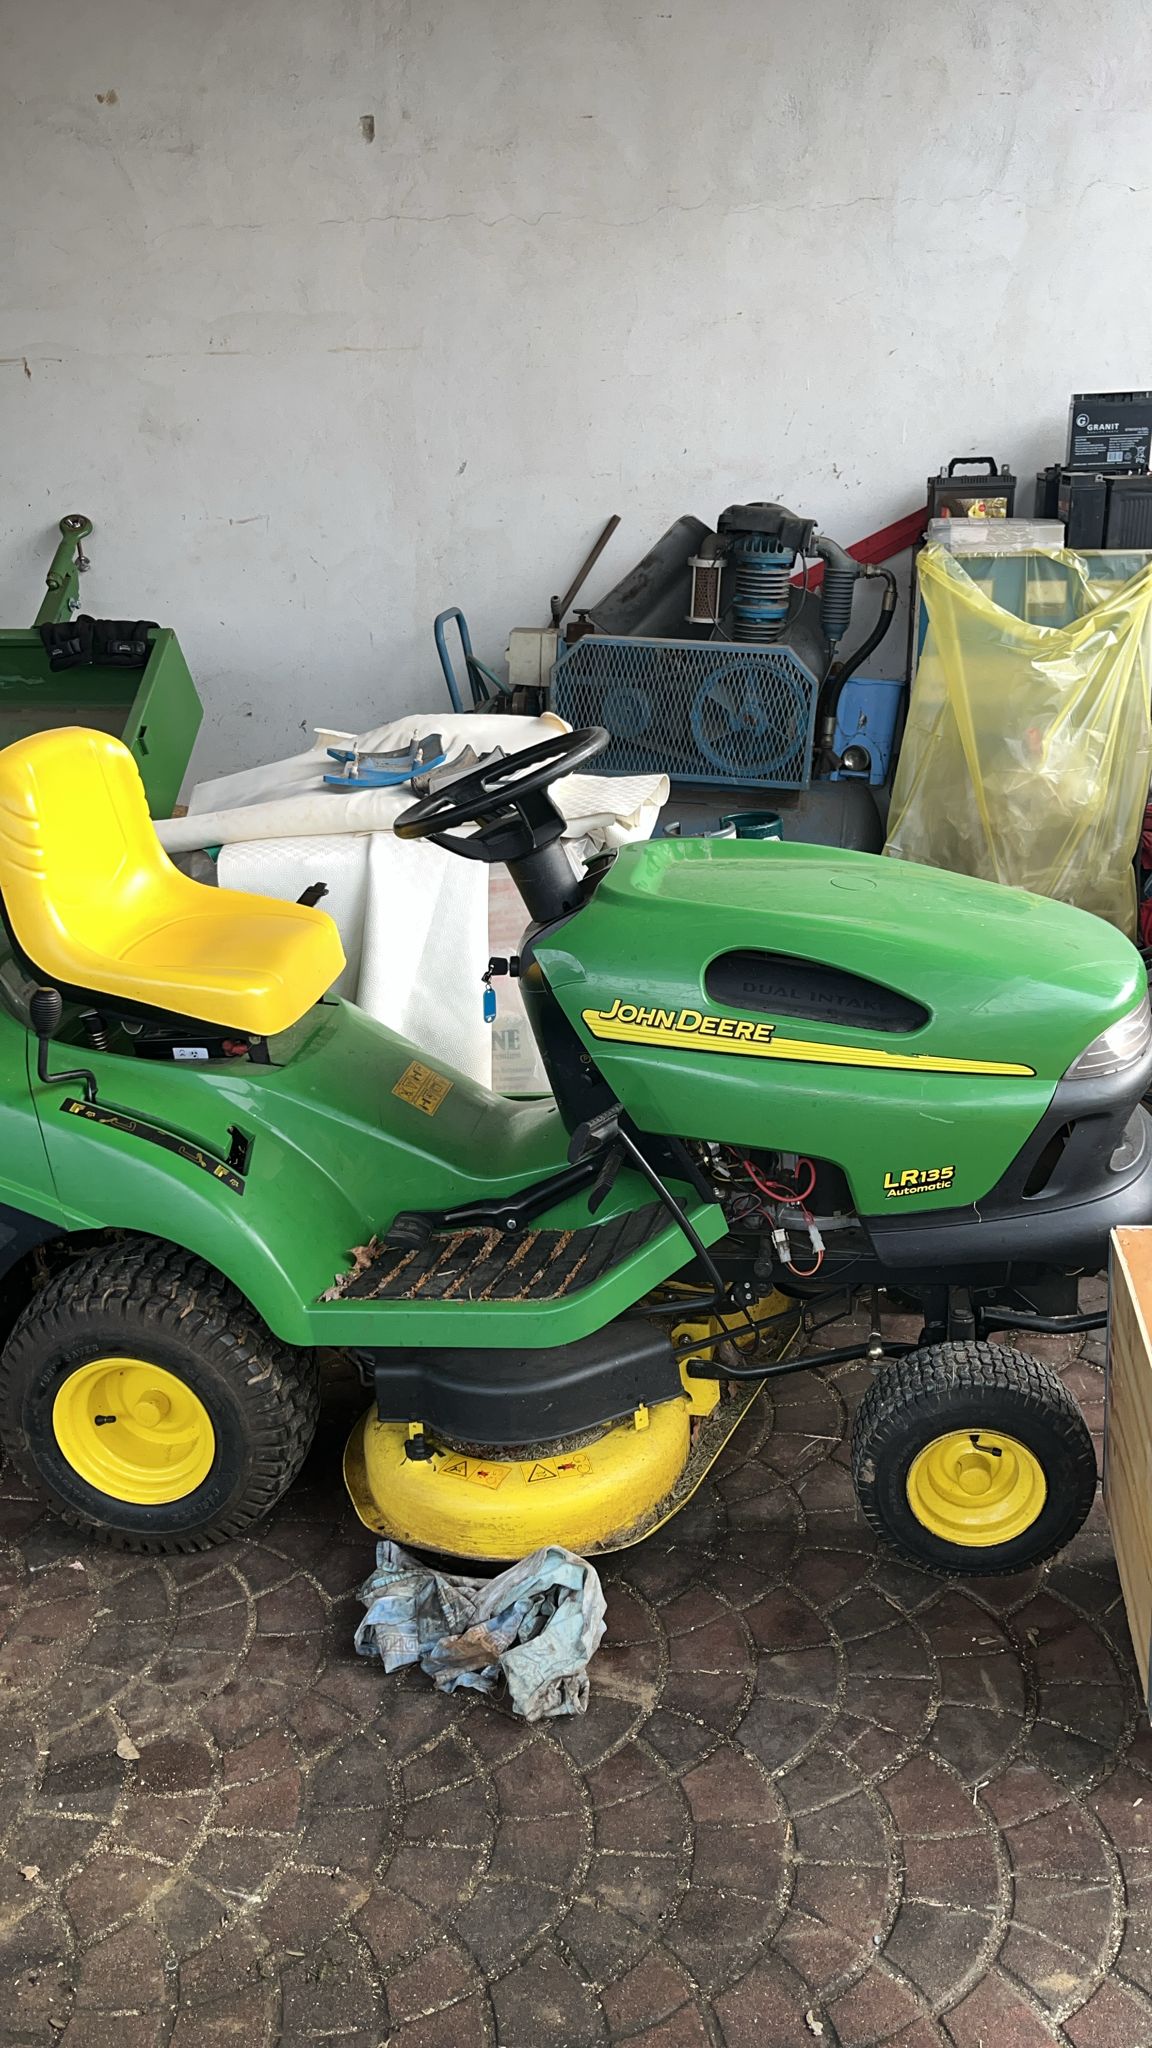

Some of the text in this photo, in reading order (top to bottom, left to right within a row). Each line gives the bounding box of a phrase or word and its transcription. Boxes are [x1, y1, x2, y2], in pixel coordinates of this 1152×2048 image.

[1086, 423, 1120, 431] GRANIT
[742, 982, 888, 1011] DUAL INTAK
[599, 999, 775, 1043] JOHN DEERE
[883, 1165, 955, 1189] LR135
[886, 1180, 952, 1197] Automatic
